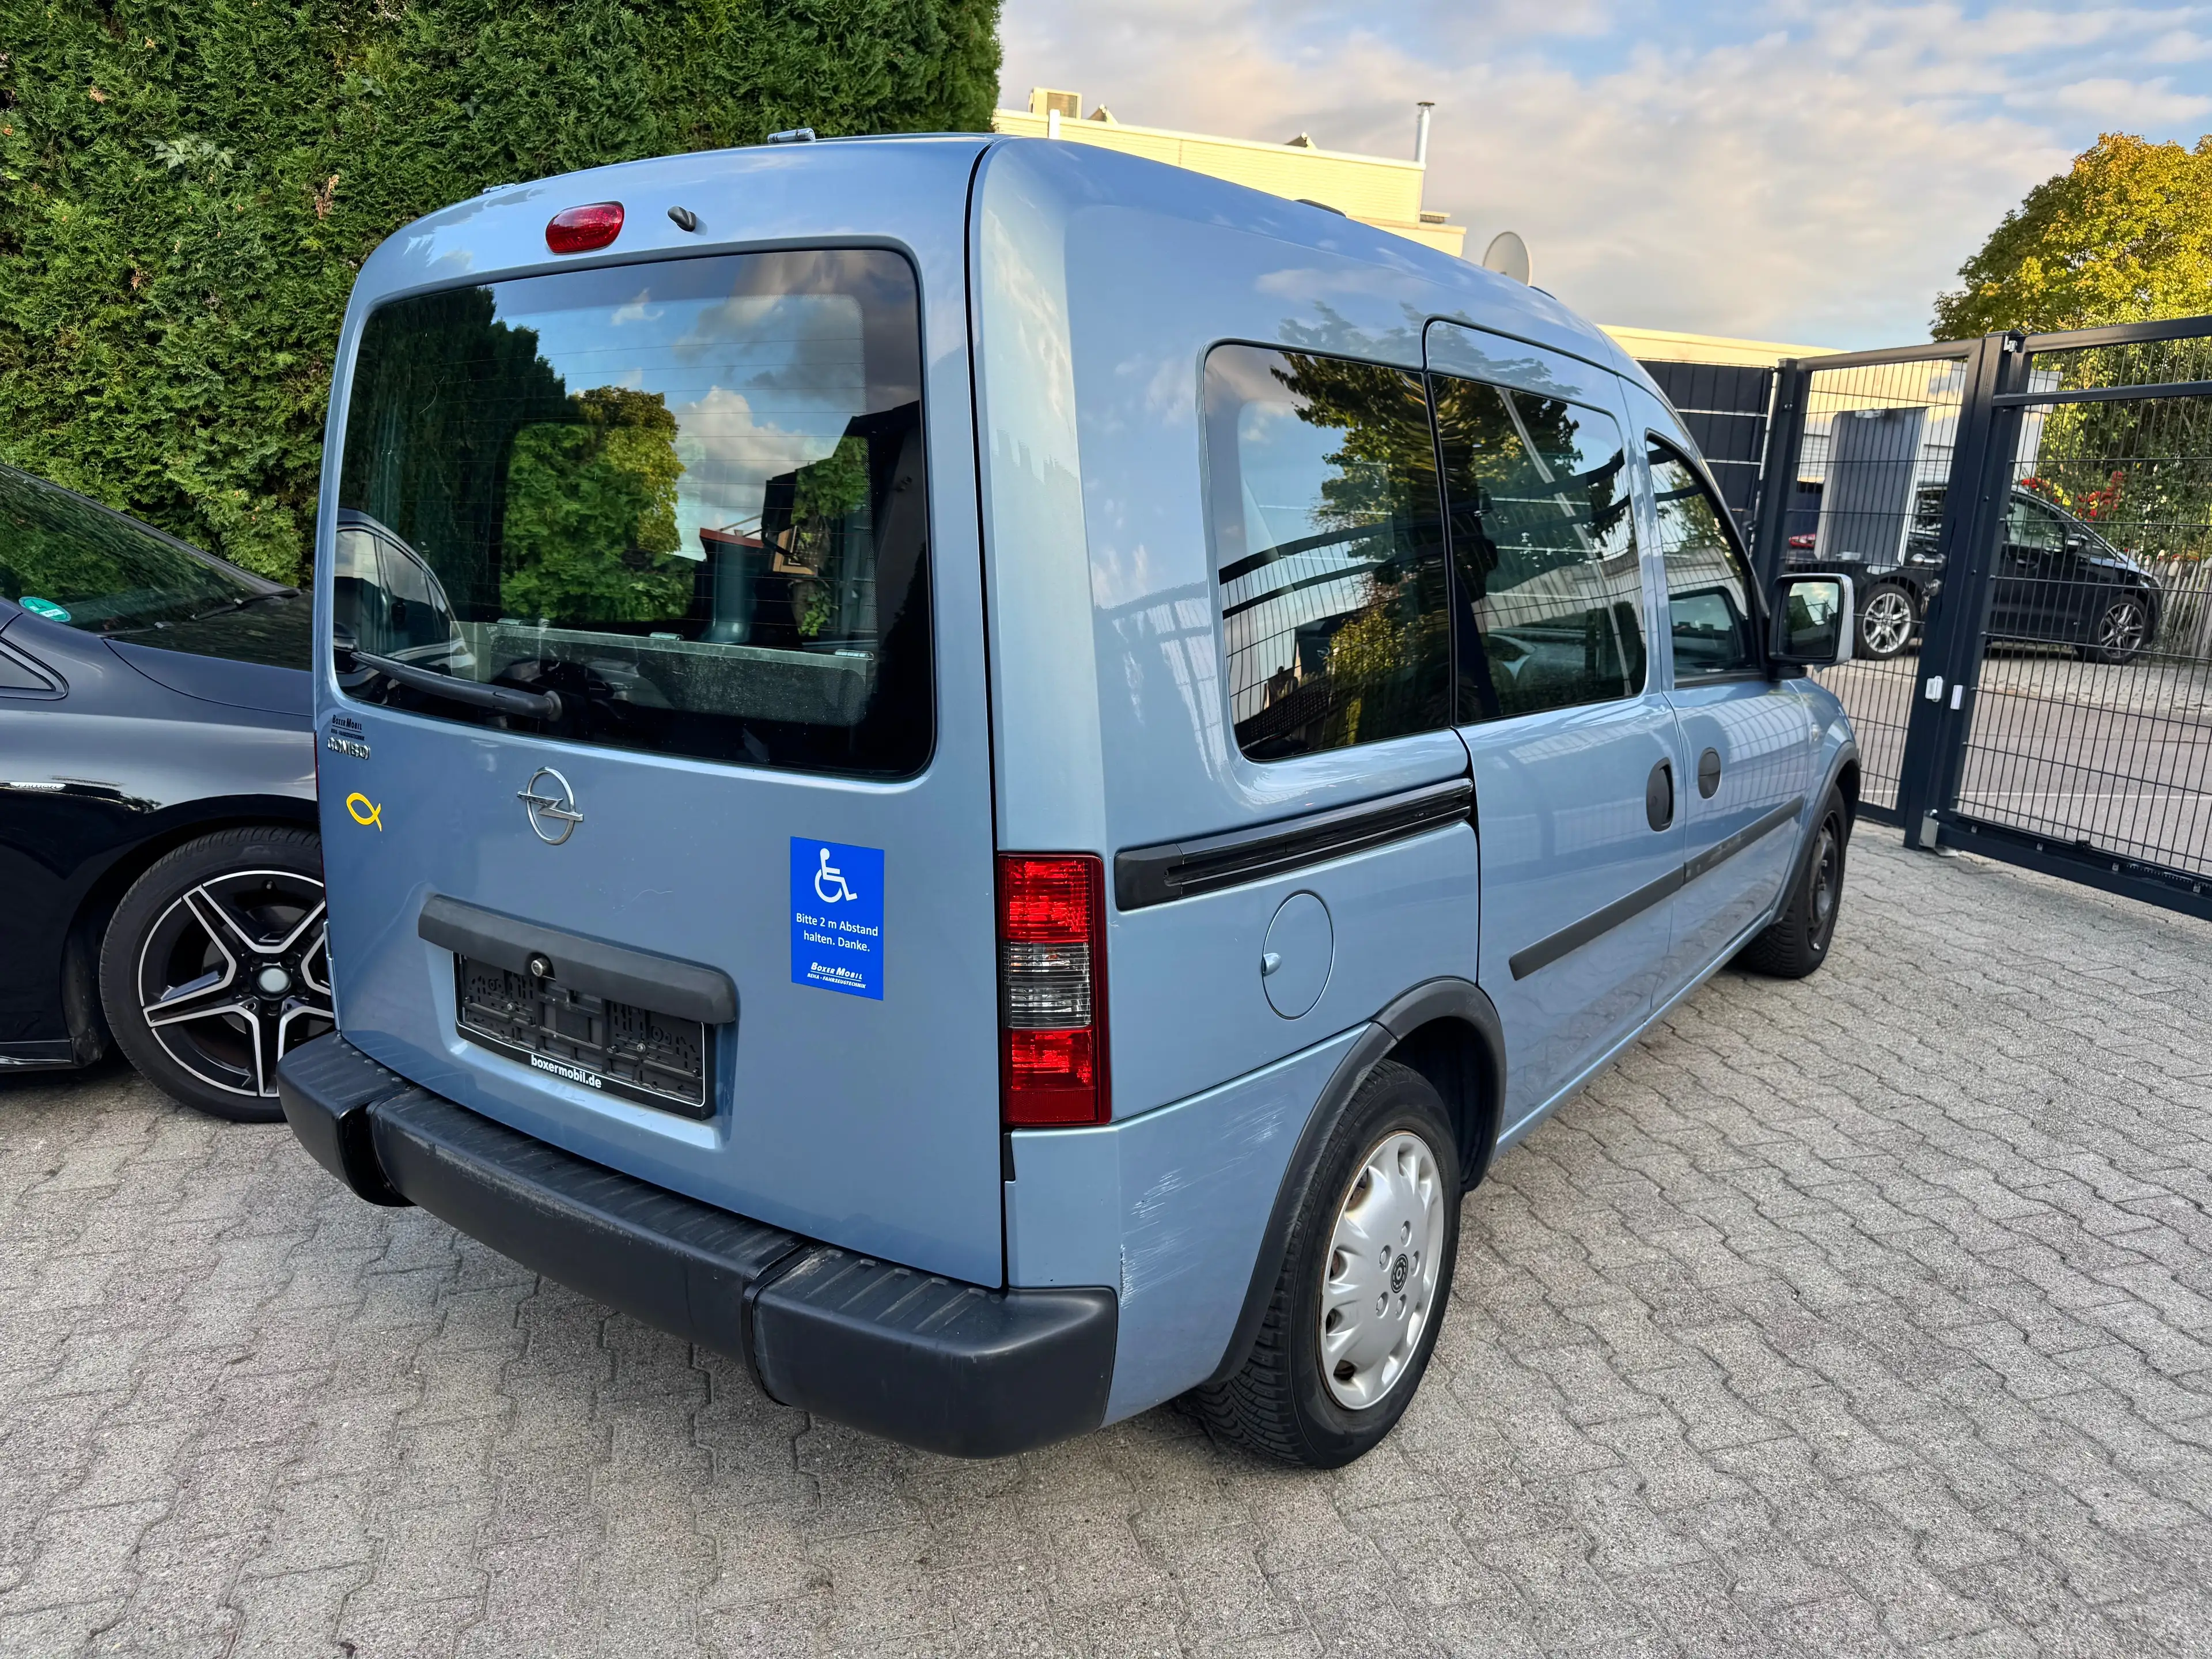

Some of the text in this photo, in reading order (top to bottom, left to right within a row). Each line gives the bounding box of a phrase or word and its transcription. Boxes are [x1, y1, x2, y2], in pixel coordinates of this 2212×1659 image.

[796, 912, 878, 937] Bitte 2 m Abstand
[804, 930, 870, 952] halten. Danke.
[810, 961, 862, 980] BOXER MOBIL
[823, 976, 866, 988] FAHRZEUGTECHNIK
[531, 1054, 602, 1088] boxermobil.de
